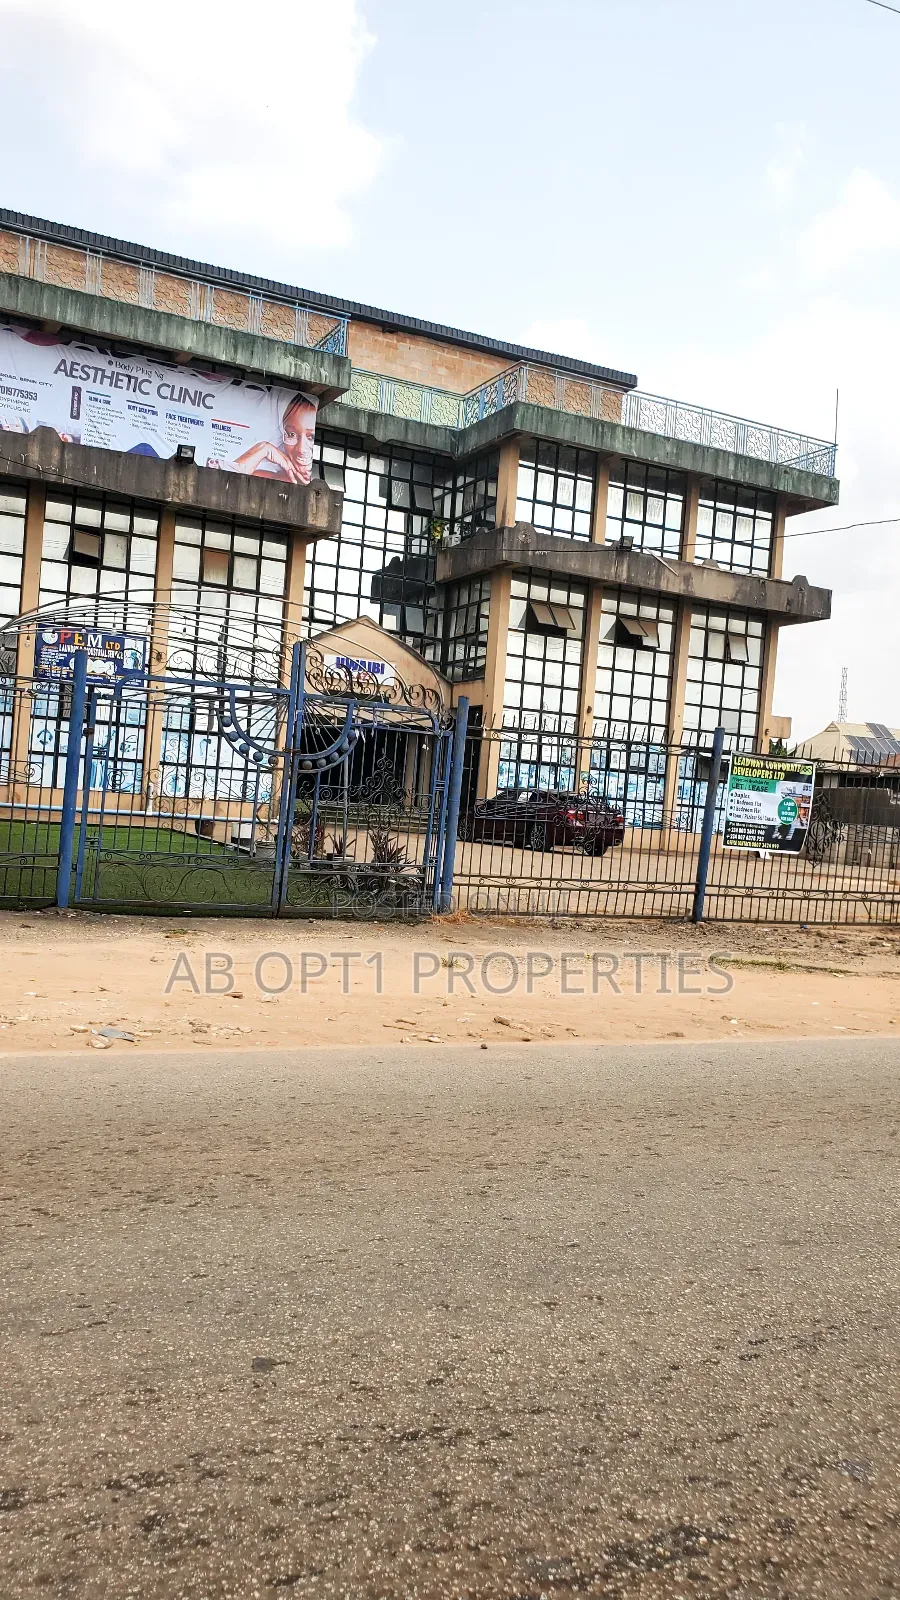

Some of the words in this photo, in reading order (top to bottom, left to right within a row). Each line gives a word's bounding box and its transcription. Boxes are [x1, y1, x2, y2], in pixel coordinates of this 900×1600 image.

[115, 360, 134, 374] Body
[53, 358, 152, 396] AESTHETIC
[156, 382, 216, 410] CLINIC
[211, 422, 232, 433] WELLNESS
[105, 641, 121, 651] LTD
[734, 756, 764, 768] LEADWAY
[765, 760, 801, 773] CORPORATE
[733, 766, 773, 780] DEVELOPERS
[774, 771, 786, 781] LTD
[748, 784, 769, 793] LEASE
